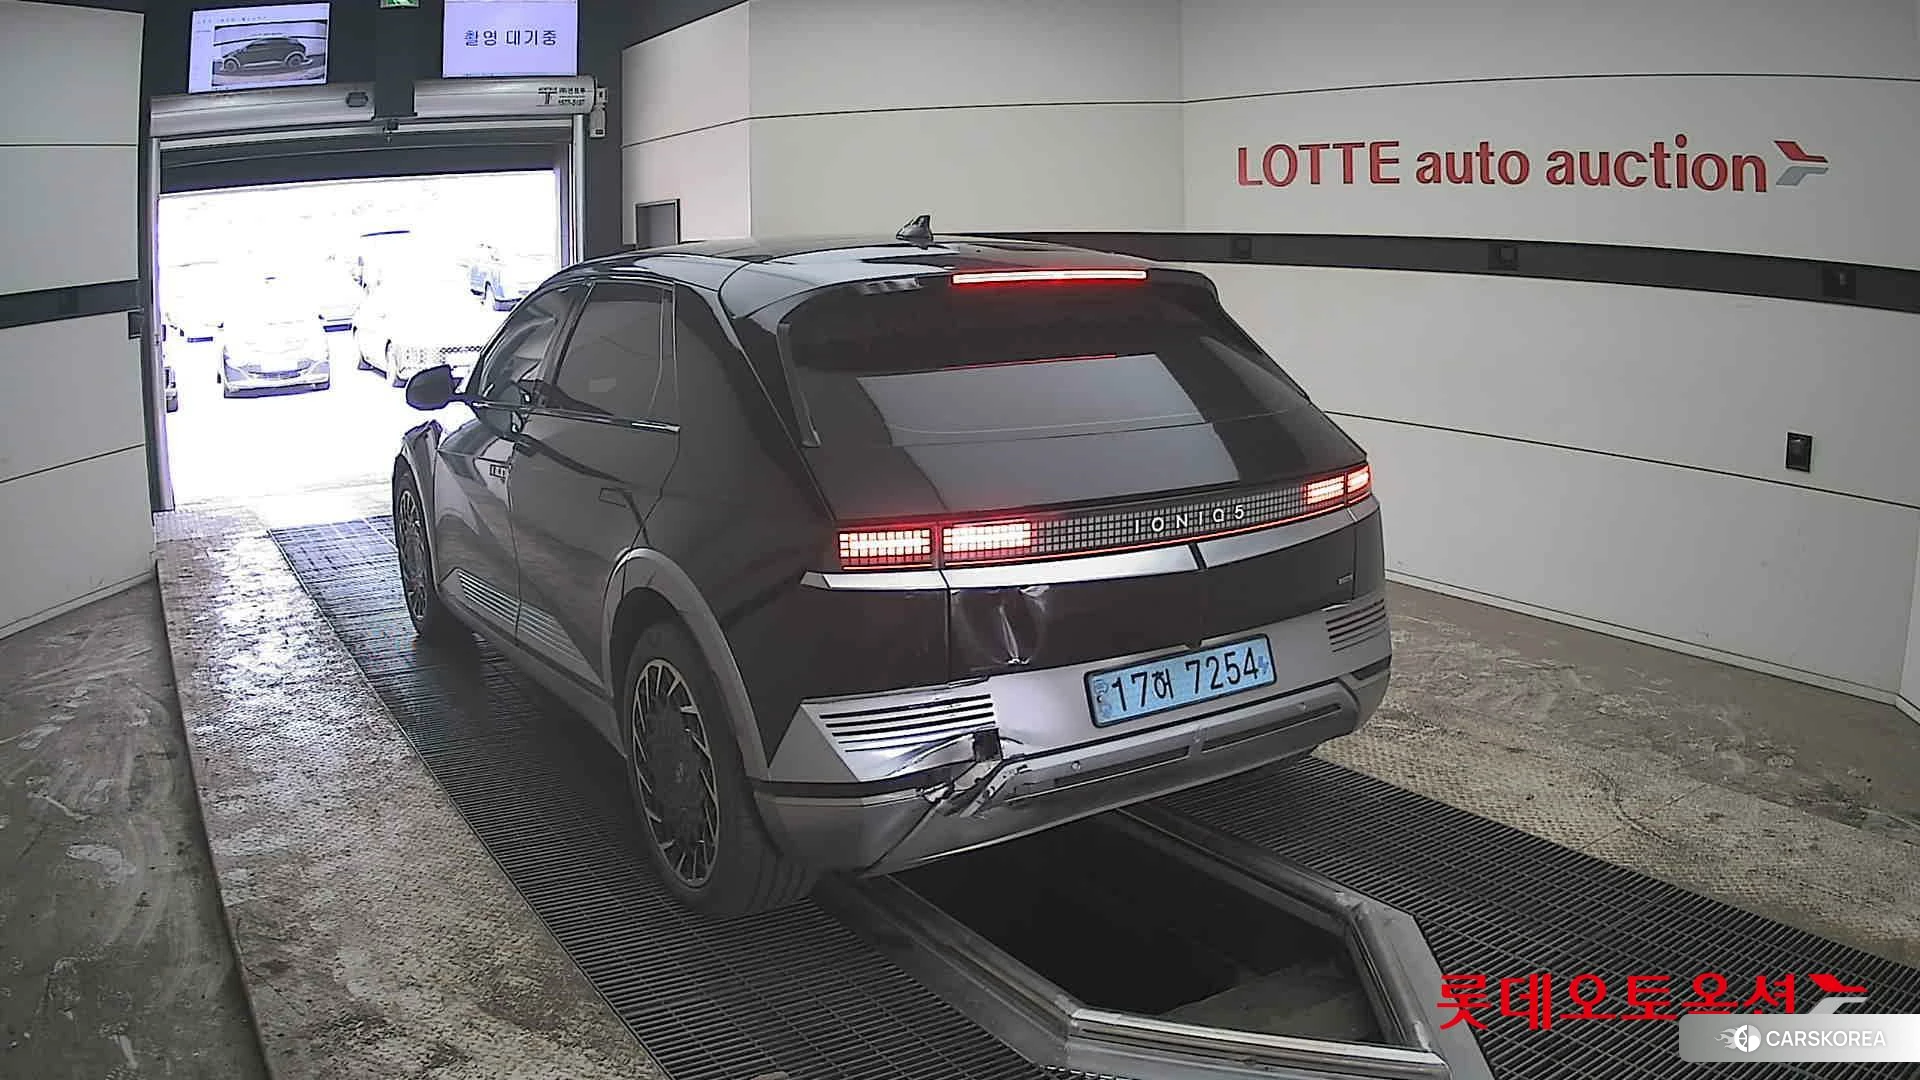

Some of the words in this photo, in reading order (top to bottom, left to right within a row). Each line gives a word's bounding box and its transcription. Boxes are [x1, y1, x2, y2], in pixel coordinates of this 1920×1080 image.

[506, 30, 557, 46] 대기중
[1236, 139, 1401, 188] LOTTE
[1415, 140, 1531, 186] auto
[1545, 133, 1768, 193] auction
[1134, 508, 1225, 534] IONIQ
[1234, 504, 1245, 520] 5
[1111, 668, 1174, 712] 17허
[1184, 646, 1259, 694] 7254
